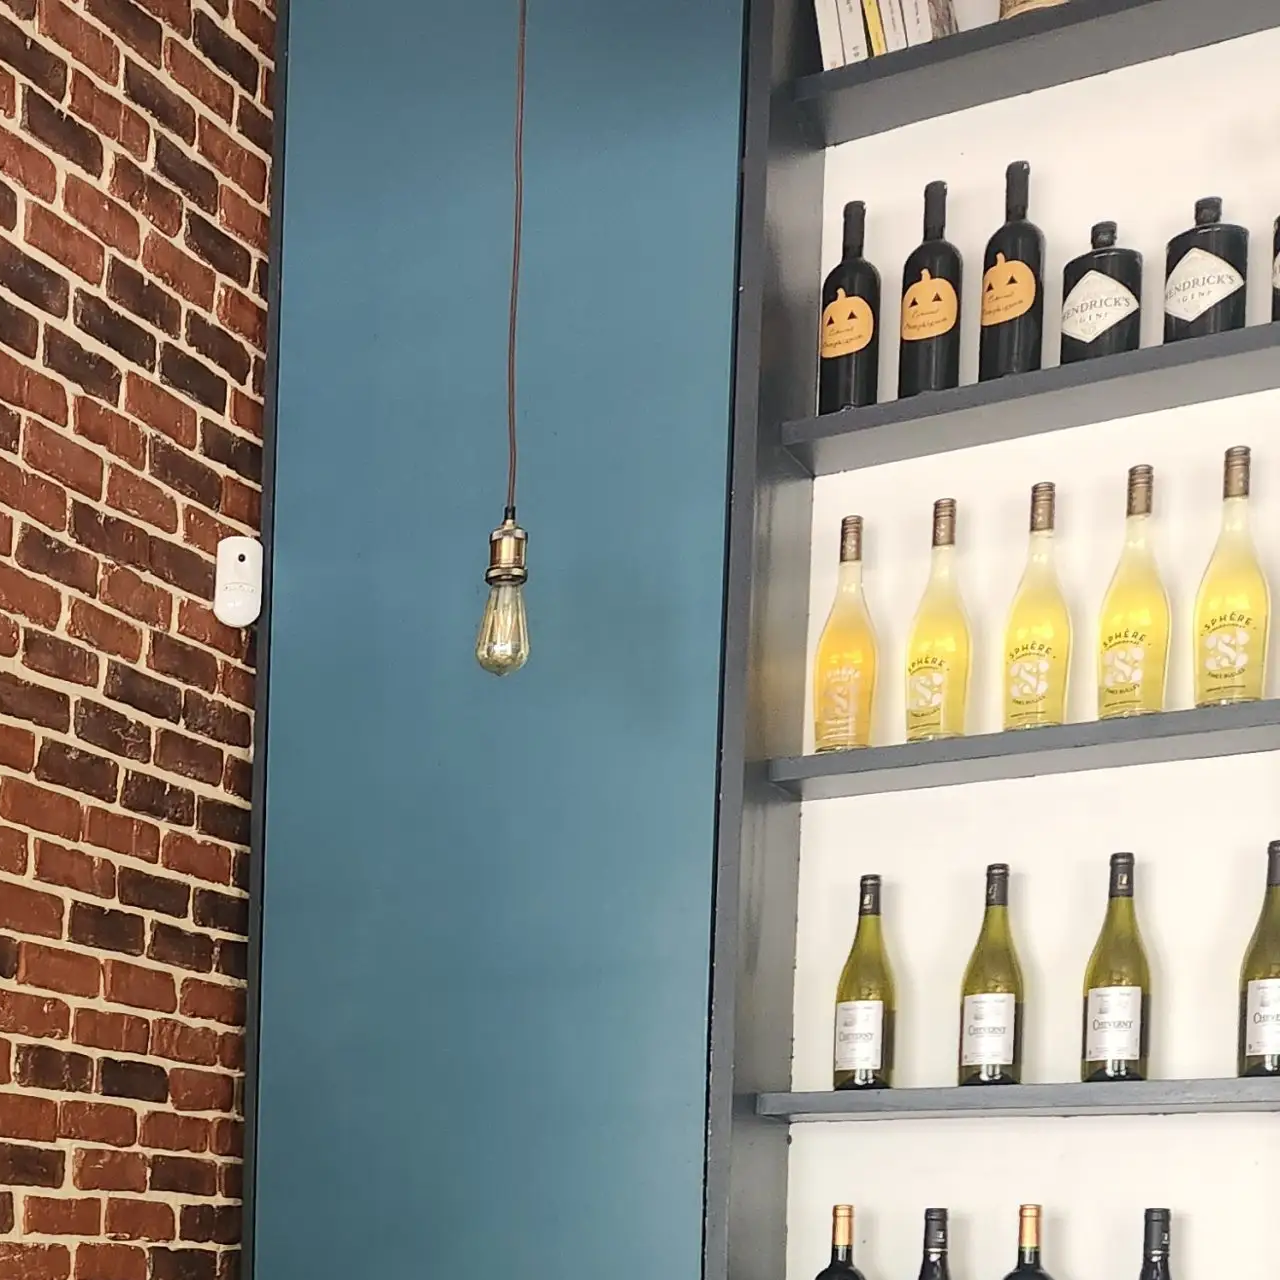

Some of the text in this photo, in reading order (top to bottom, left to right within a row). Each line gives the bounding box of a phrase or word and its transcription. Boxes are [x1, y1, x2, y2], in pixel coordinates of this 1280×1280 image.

[1204, 611, 1252, 631] SPHÈRE
[1103, 628, 1147, 648] SPHÈRE
[1009, 640, 1052, 660] SPHÈRE
